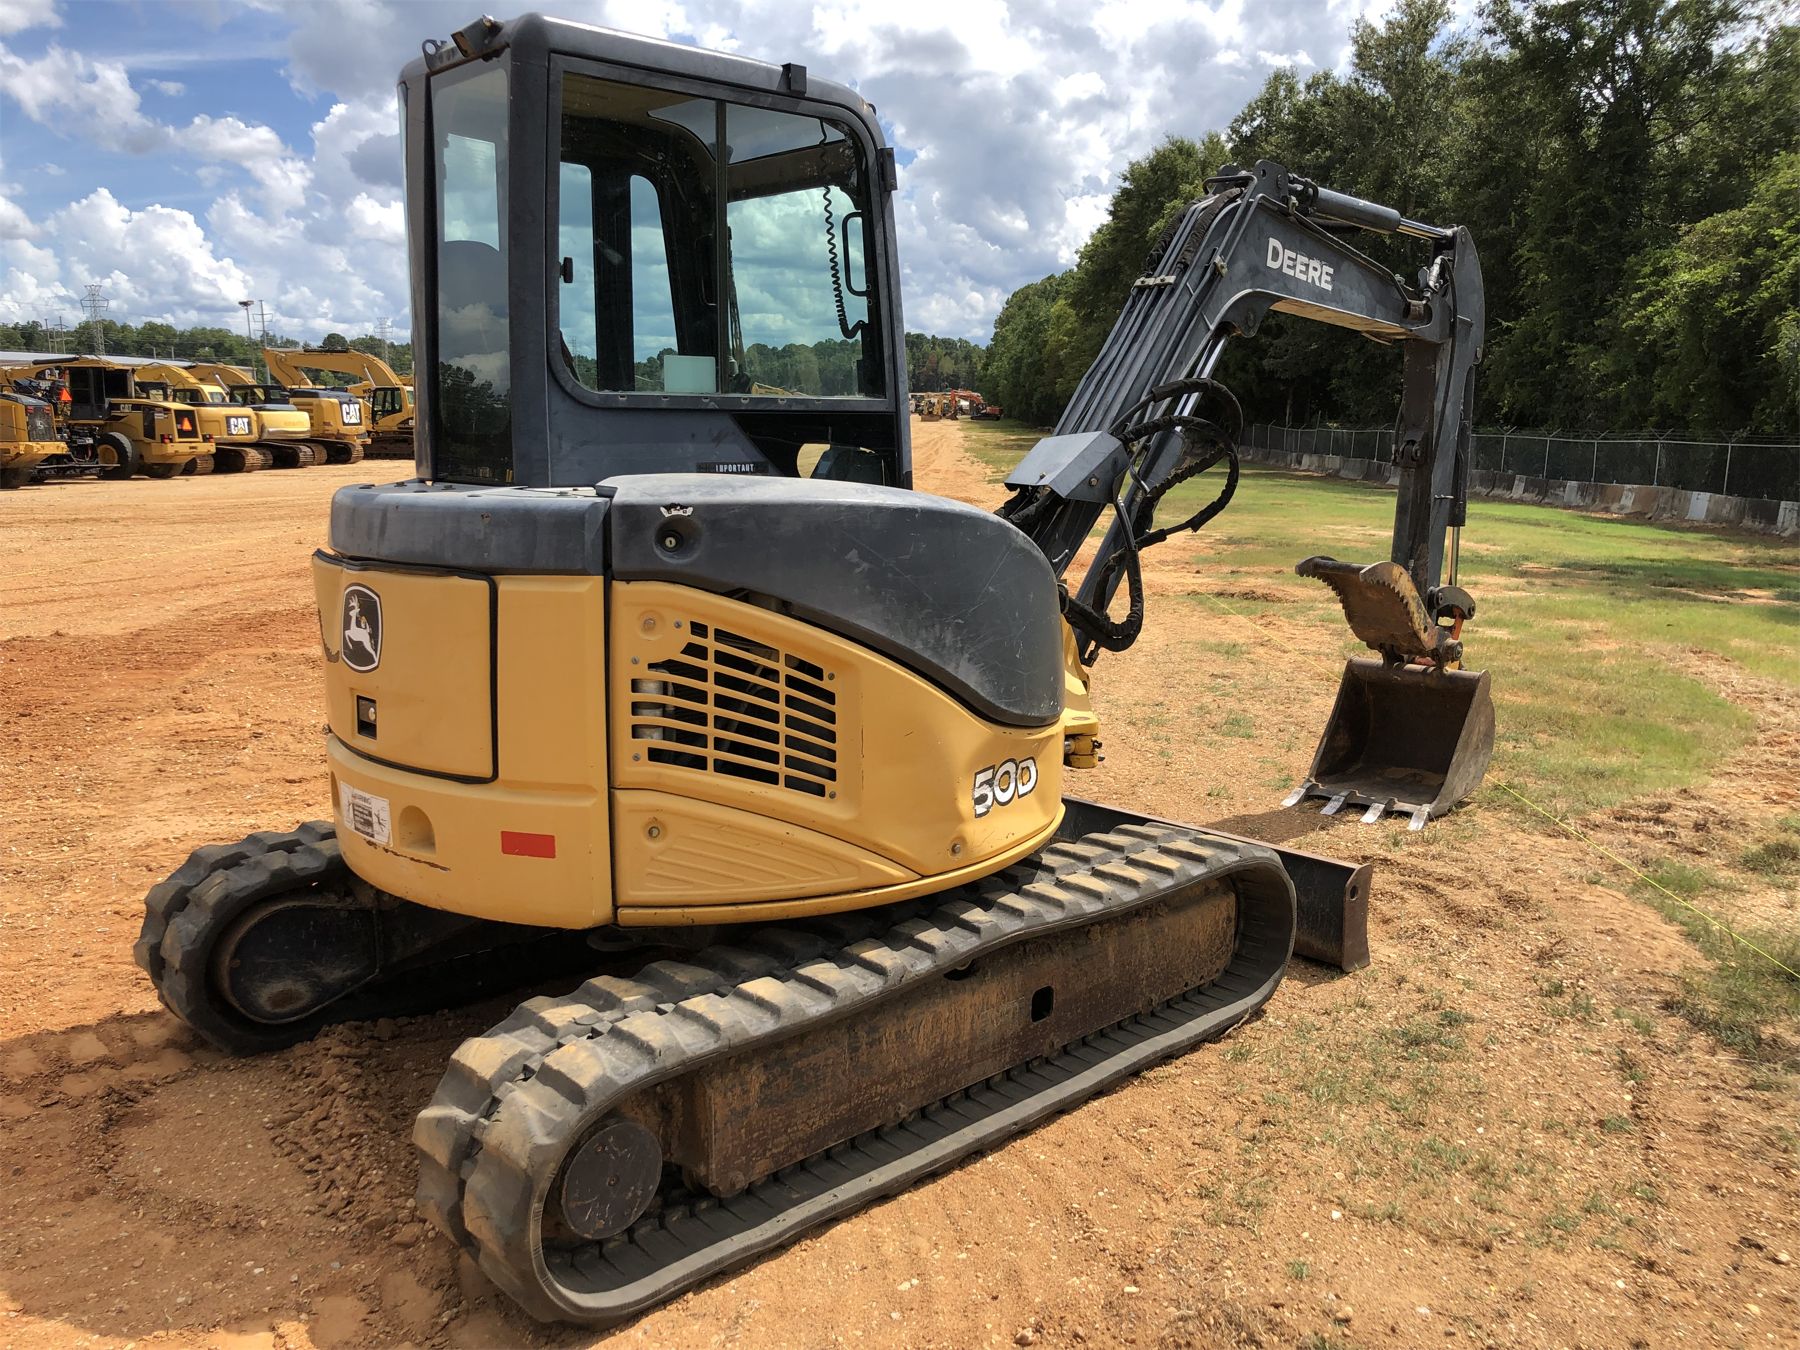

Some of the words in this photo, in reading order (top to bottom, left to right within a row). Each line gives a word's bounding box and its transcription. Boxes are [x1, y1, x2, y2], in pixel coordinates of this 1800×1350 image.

[1266, 237, 1334, 292] DEERE
[120, 403, 133, 412] CAT
[341, 403, 361, 424] CAT
[230, 417, 250, 435] CAT
[715, 464, 754, 473] IMPORTANT
[973, 756, 1038, 819] 50D
